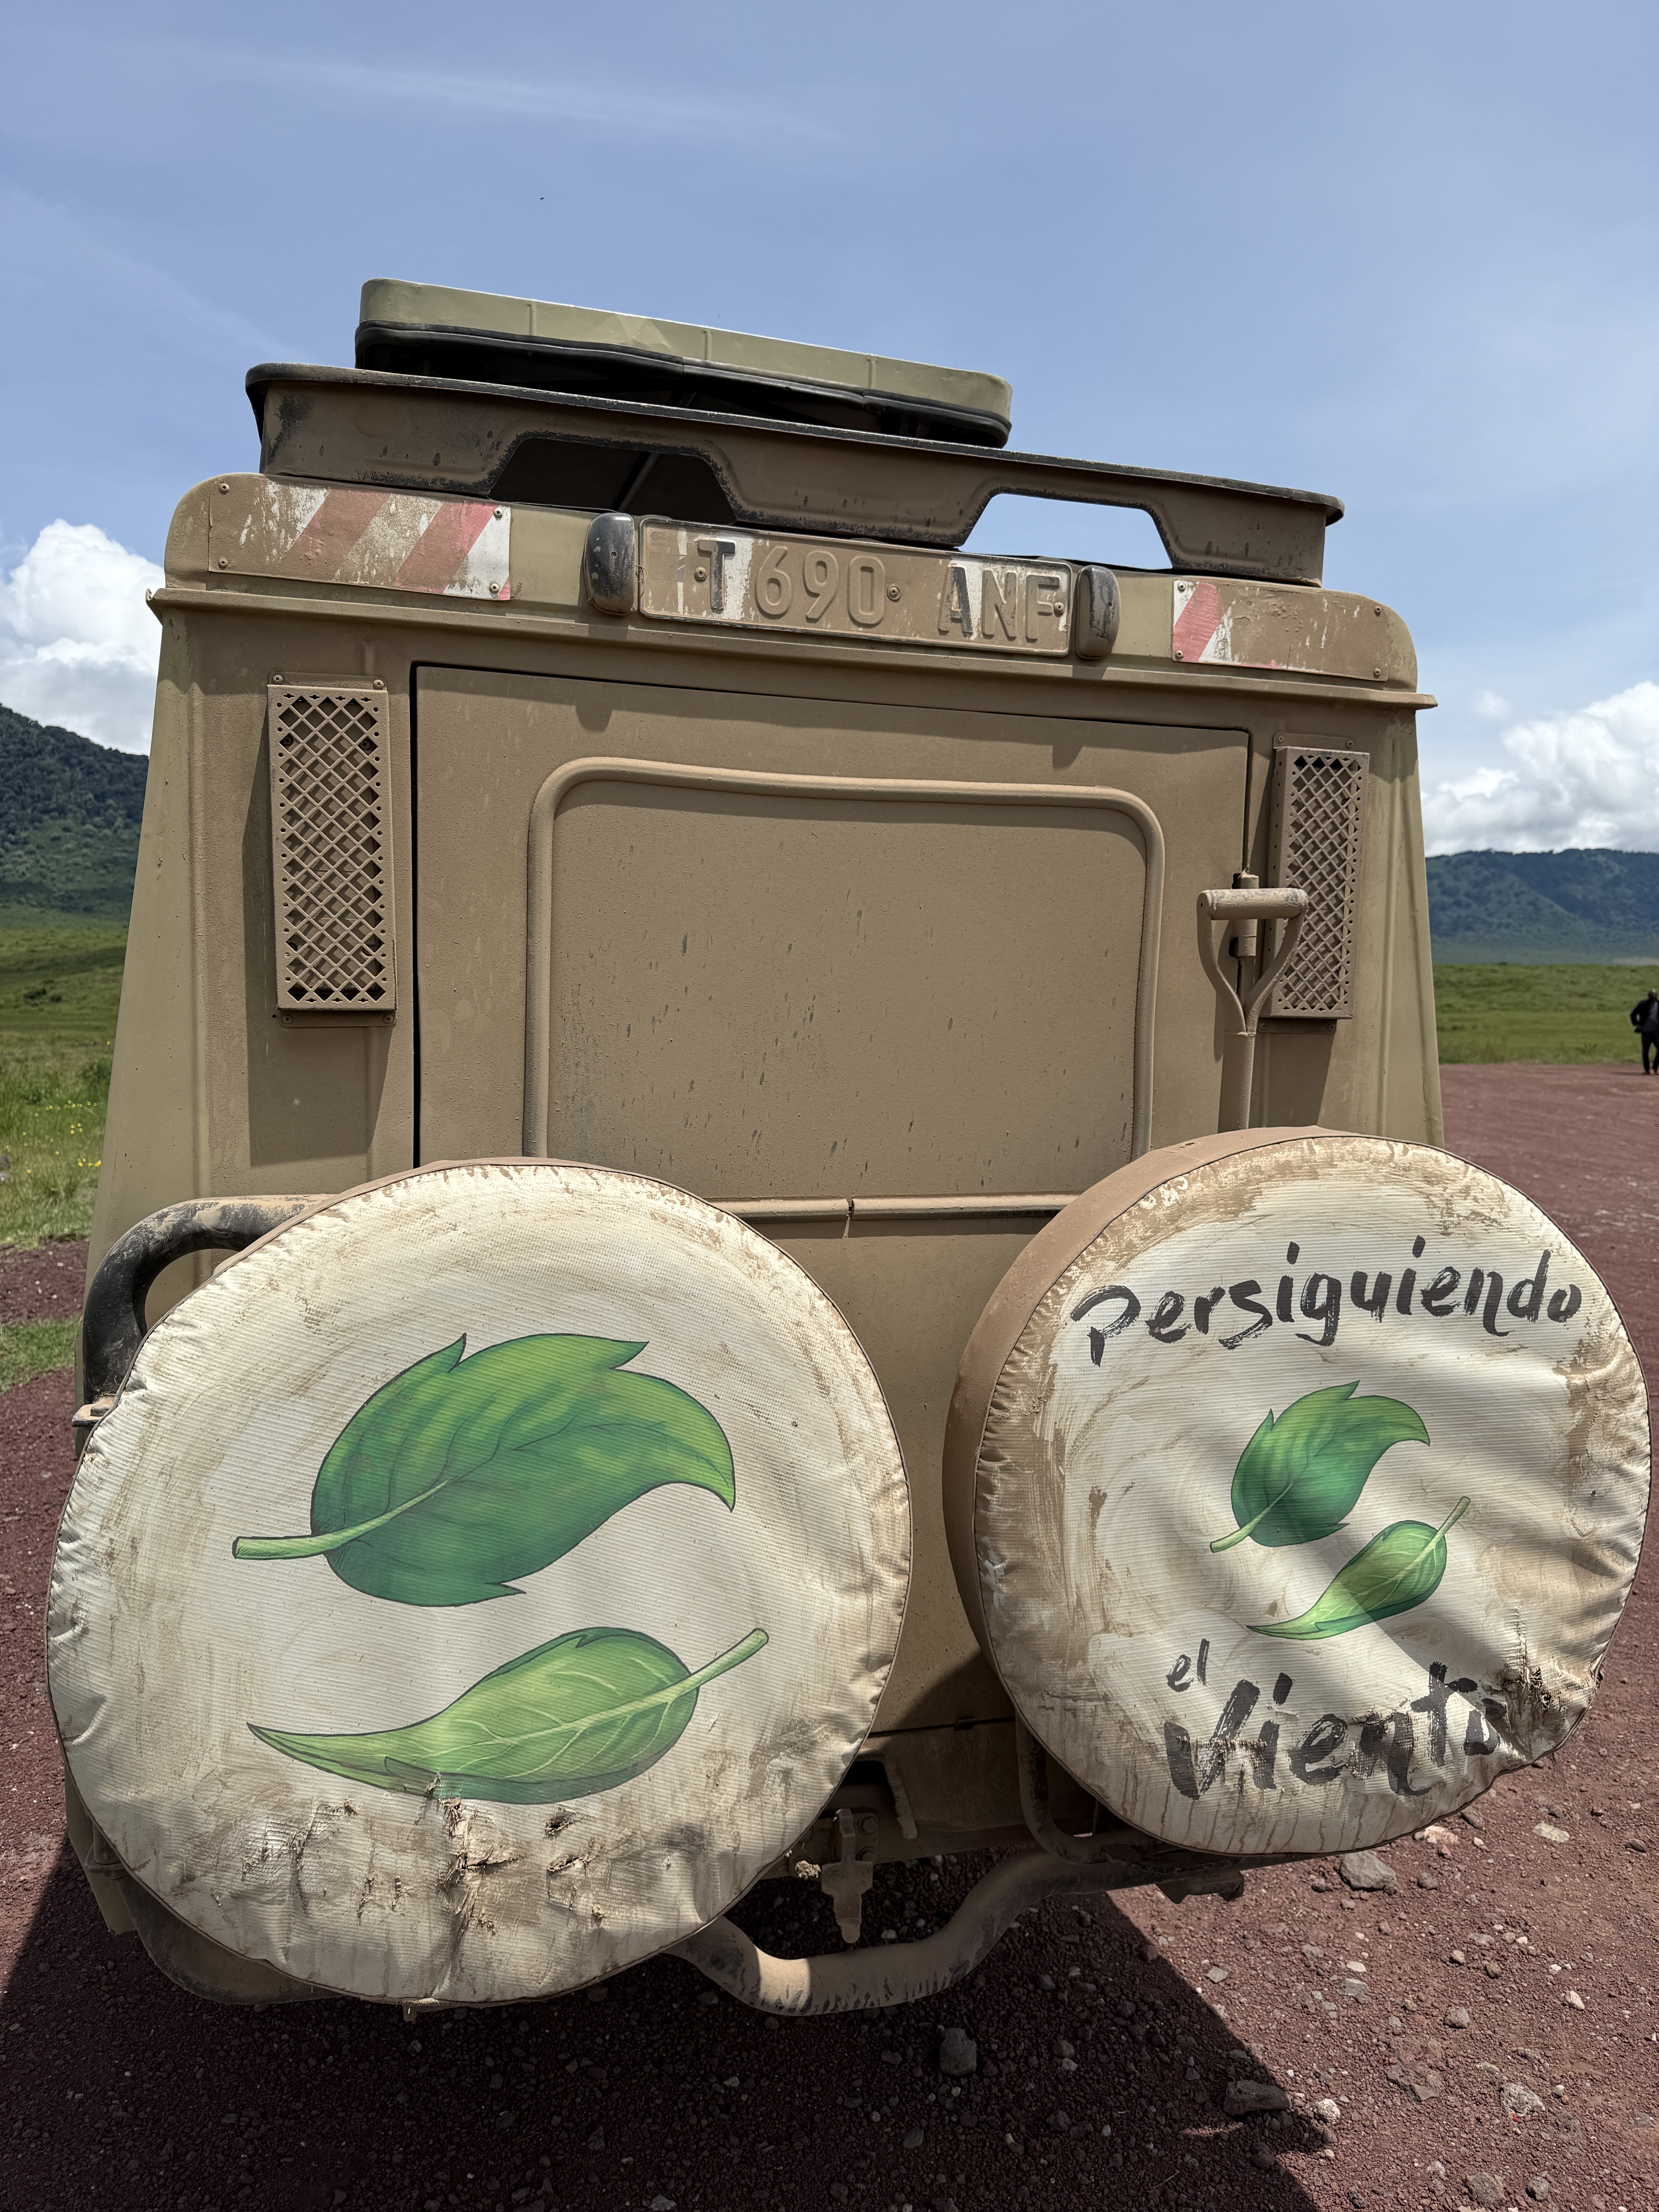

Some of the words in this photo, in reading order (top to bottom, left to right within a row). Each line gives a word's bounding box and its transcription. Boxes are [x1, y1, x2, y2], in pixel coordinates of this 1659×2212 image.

[697, 539, 736, 613] T
[755, 546, 886, 627] 690
[938, 565, 1060, 643] ANF
[1166, 1638, 1210, 1692] el
